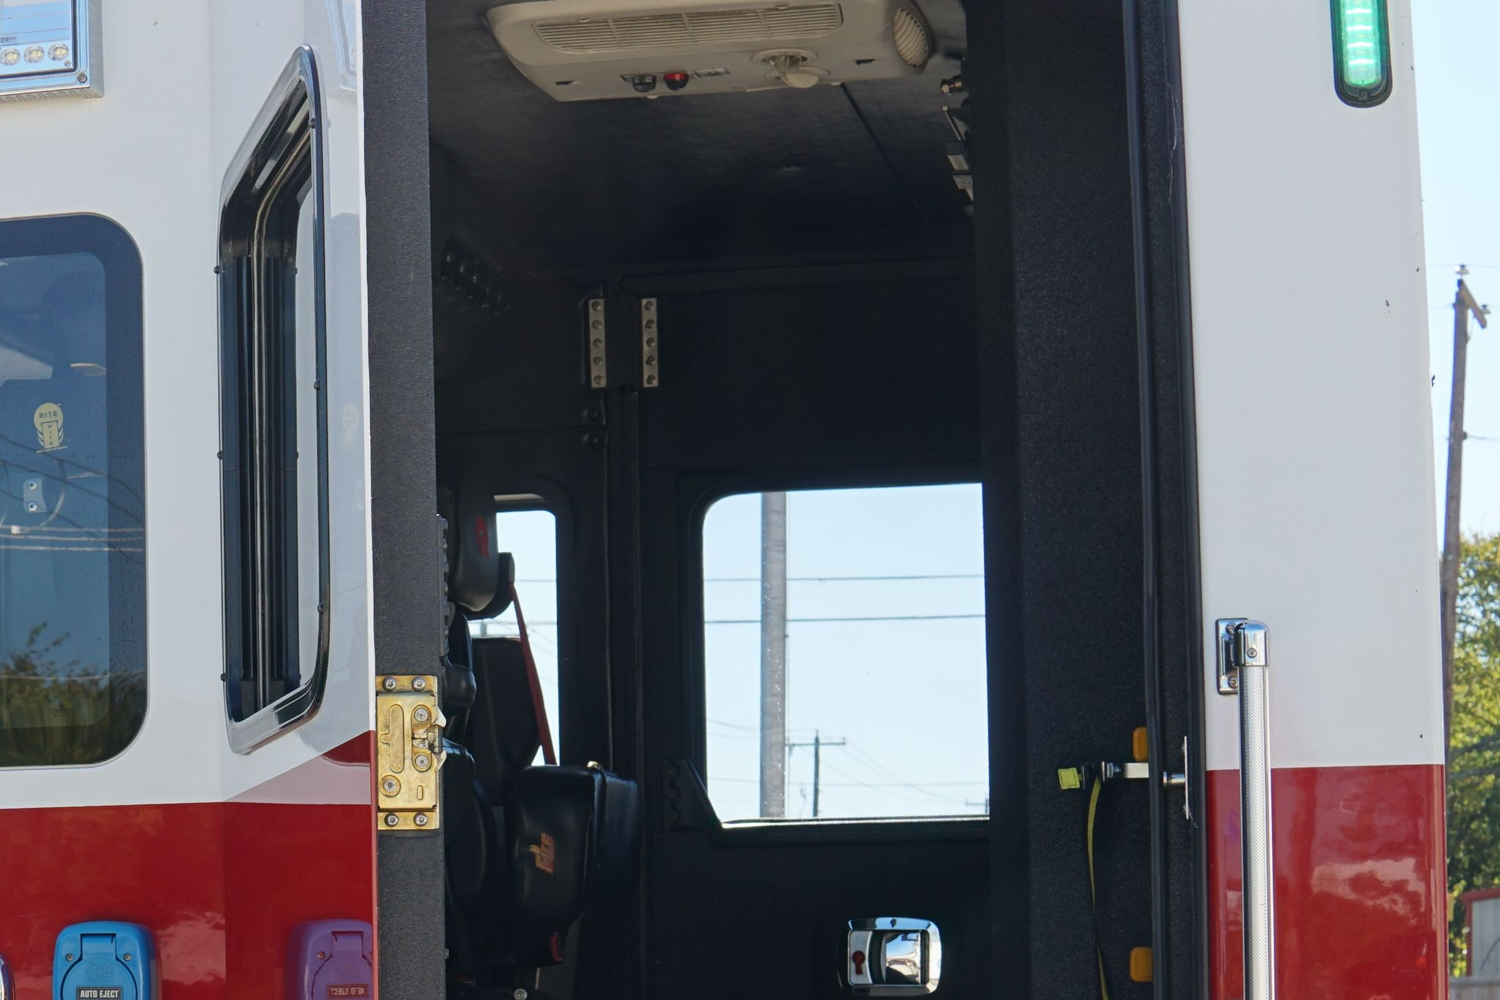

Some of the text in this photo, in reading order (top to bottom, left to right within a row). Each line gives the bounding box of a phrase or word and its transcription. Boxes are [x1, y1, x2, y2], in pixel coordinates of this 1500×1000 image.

[39, 411, 58, 419] RITE
[80, 990, 119, 998] AUTO EJECT
